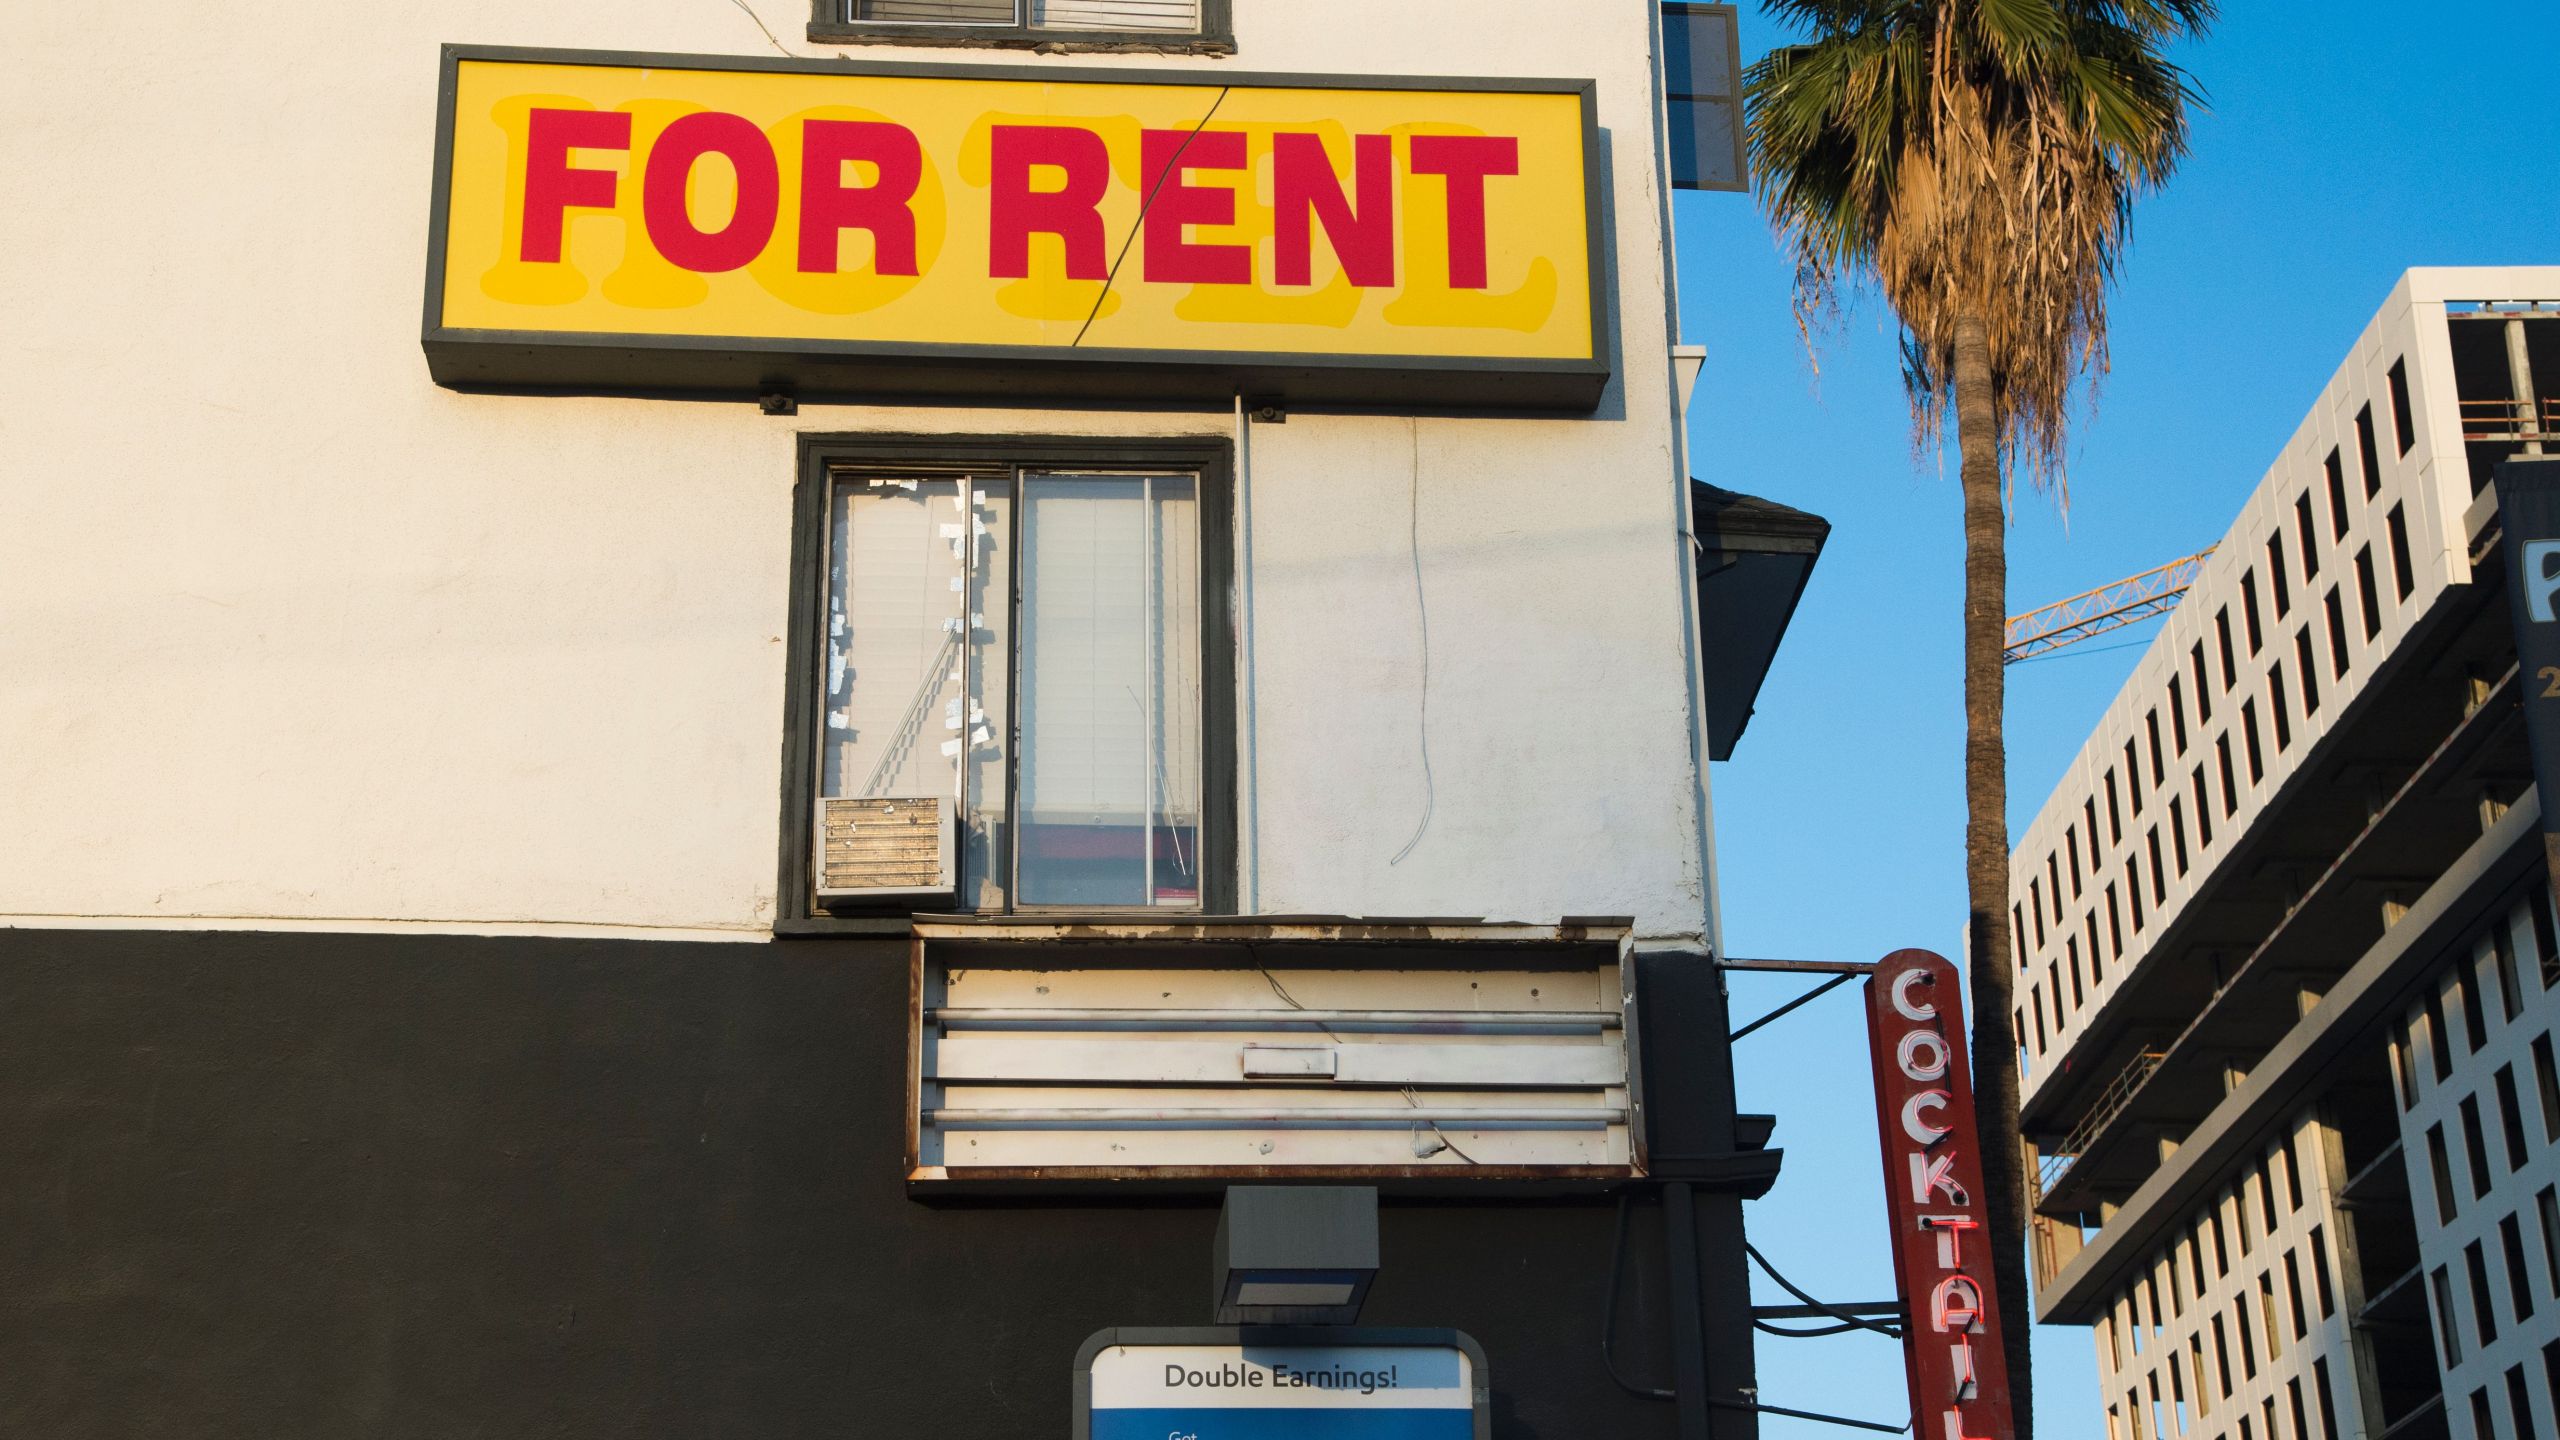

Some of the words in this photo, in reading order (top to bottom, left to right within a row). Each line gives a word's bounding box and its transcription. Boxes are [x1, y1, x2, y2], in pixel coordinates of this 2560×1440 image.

[521, 108, 922, 276] FOR
[990, 124, 1519, 290] RENT
[1165, 1363, 1264, 1387] Double
[1273, 1364, 1397, 1394] Earnings!
